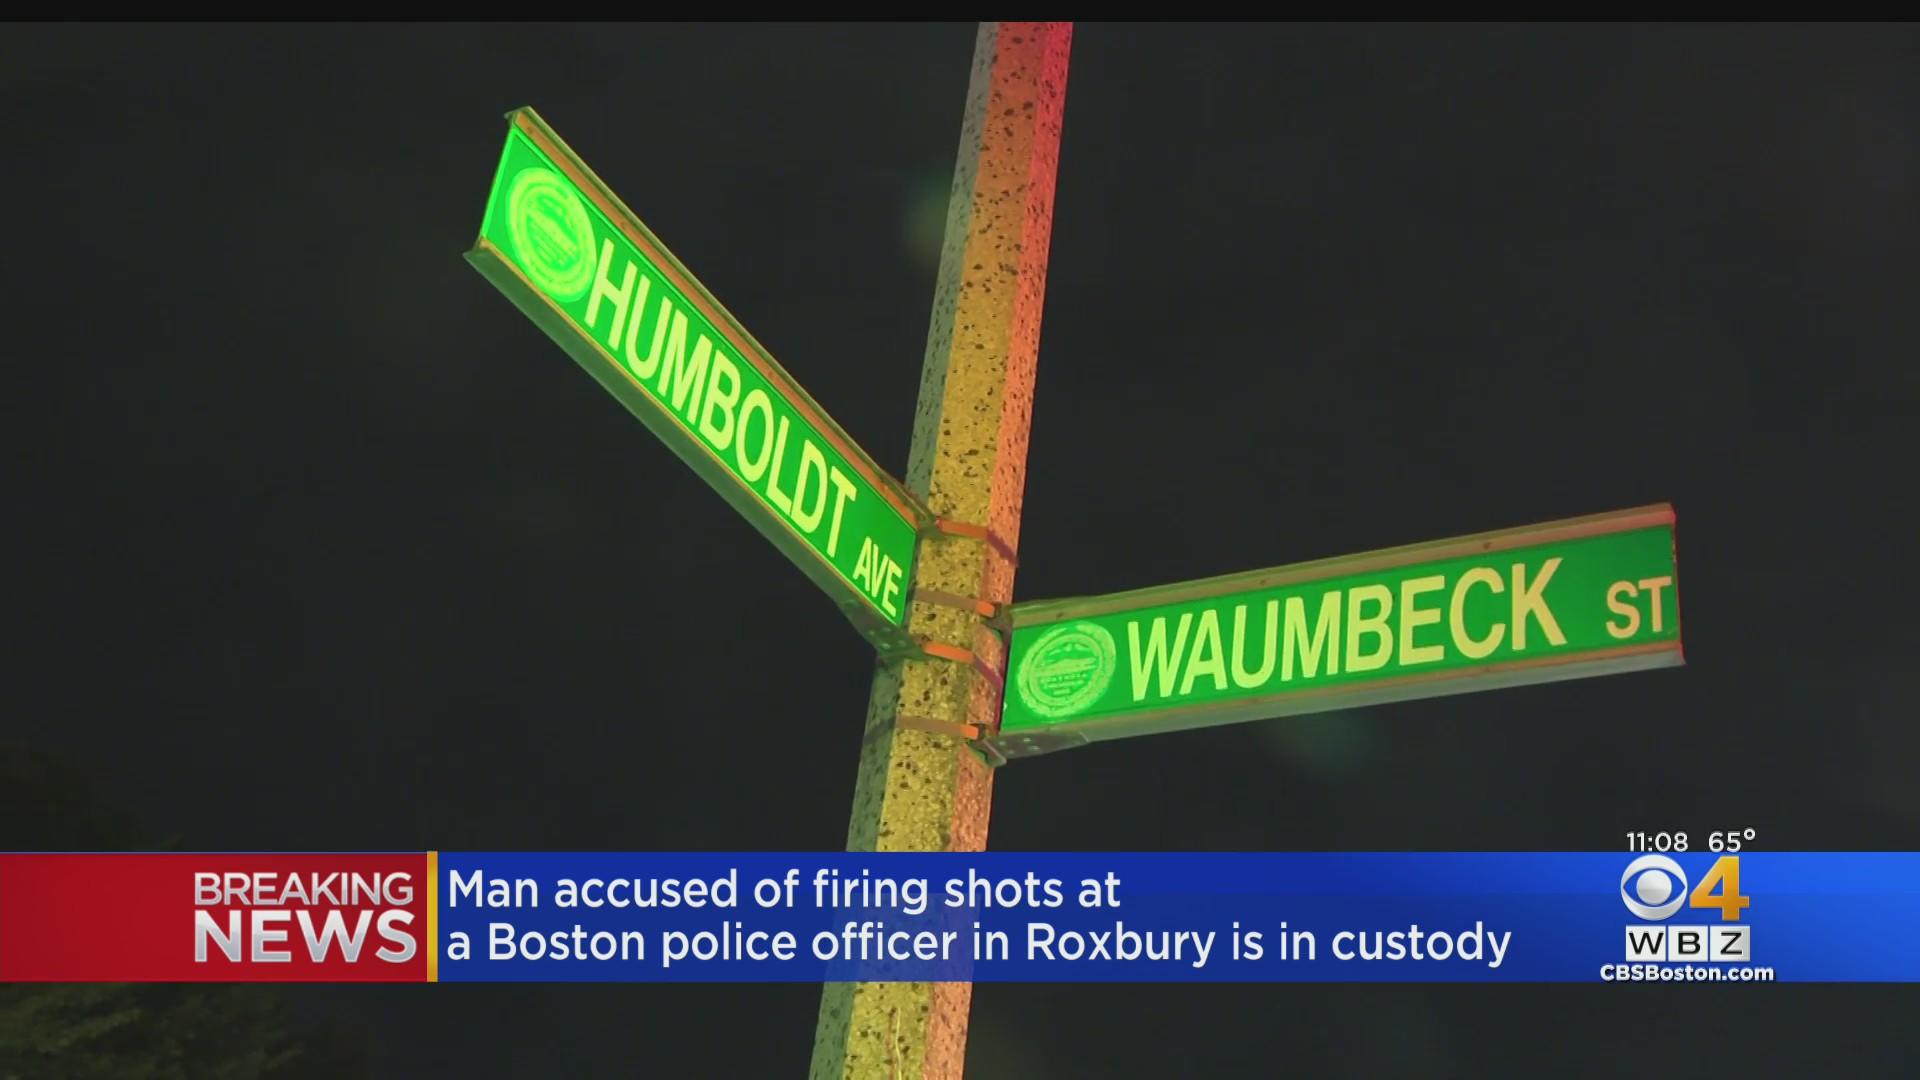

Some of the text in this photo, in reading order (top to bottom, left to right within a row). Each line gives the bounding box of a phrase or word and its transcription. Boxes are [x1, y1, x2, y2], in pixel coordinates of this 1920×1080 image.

[584, 237, 902, 617] HUMBOLDT AVE
[1127, 557, 1567, 701] WAUMBECK
[1606, 575, 1672, 639] ST
